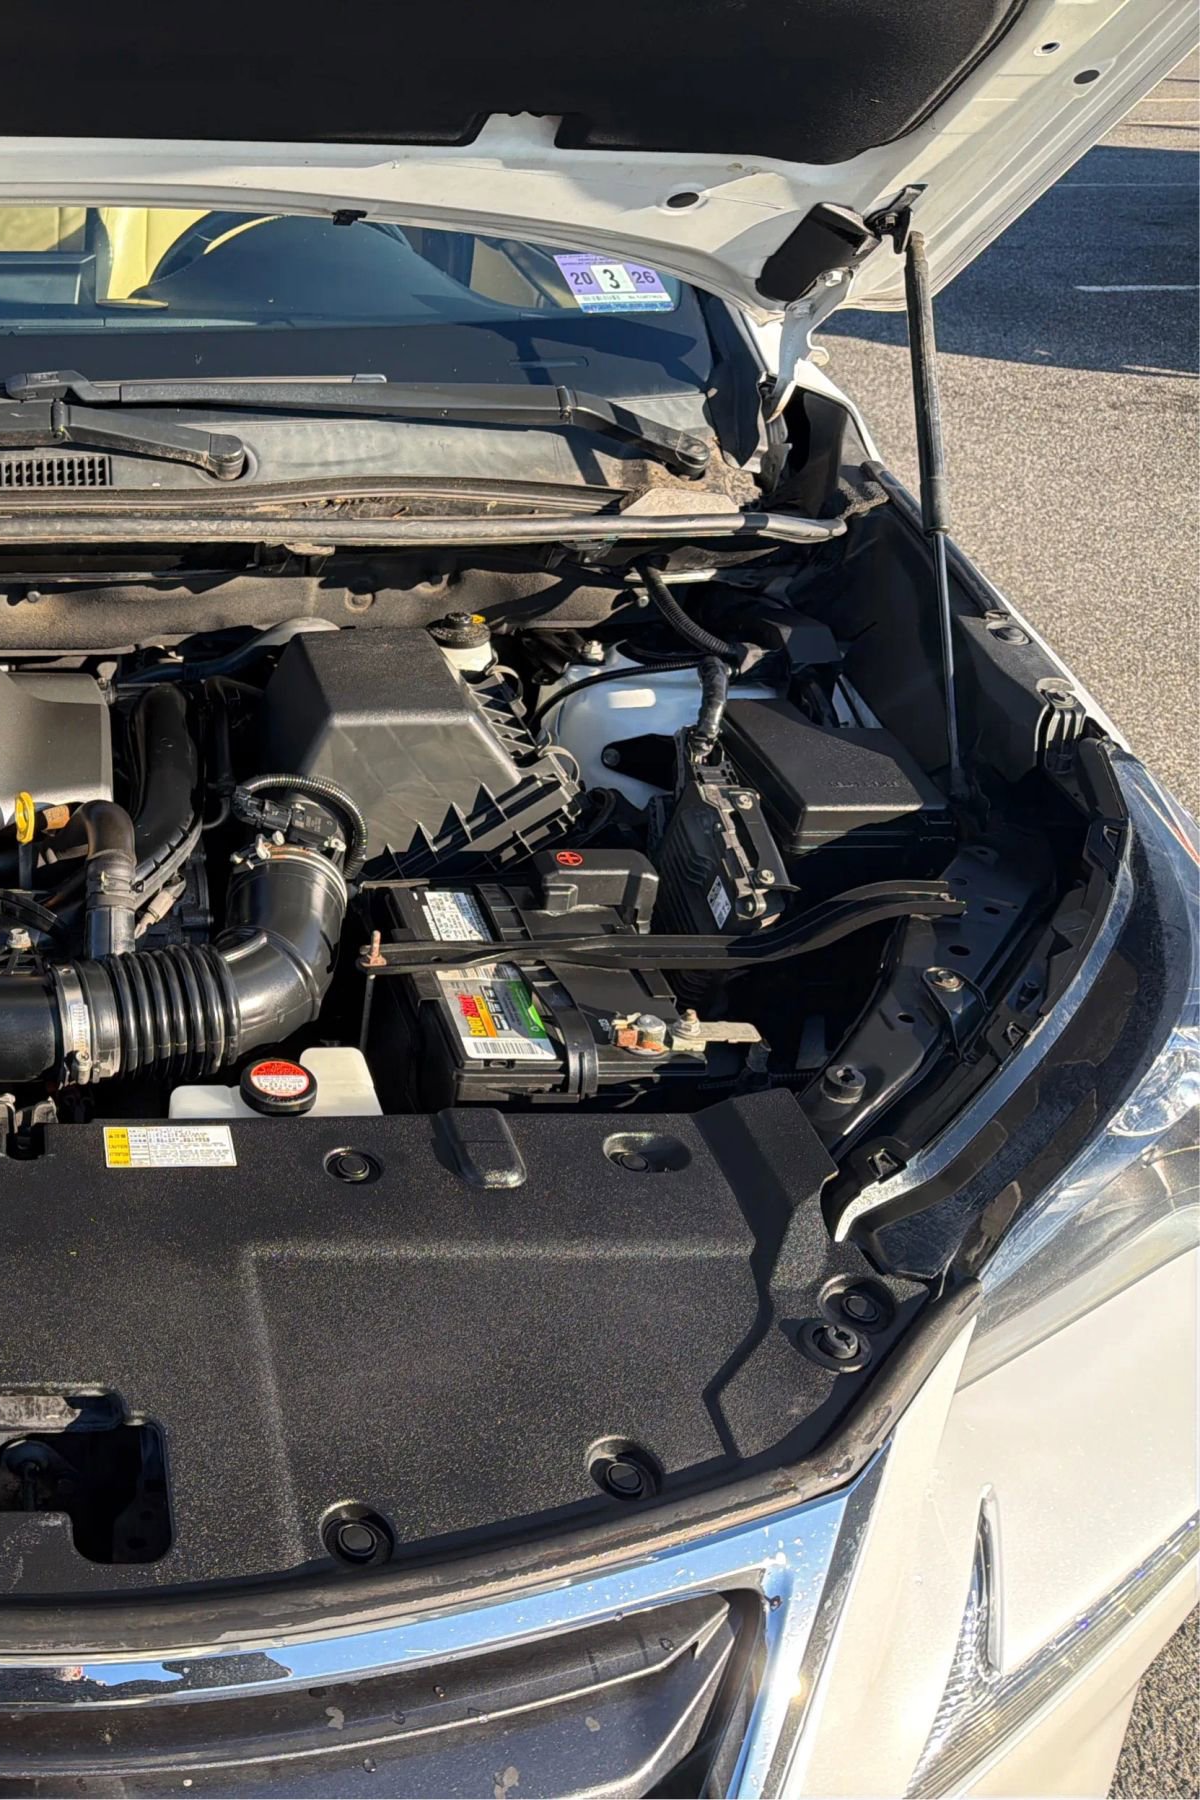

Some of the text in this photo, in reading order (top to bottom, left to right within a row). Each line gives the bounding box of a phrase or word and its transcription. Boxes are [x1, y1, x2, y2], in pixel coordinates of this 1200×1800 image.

[570, 268, 656, 289] 20 3 26
[457, 992, 489, 1037] EverStart
